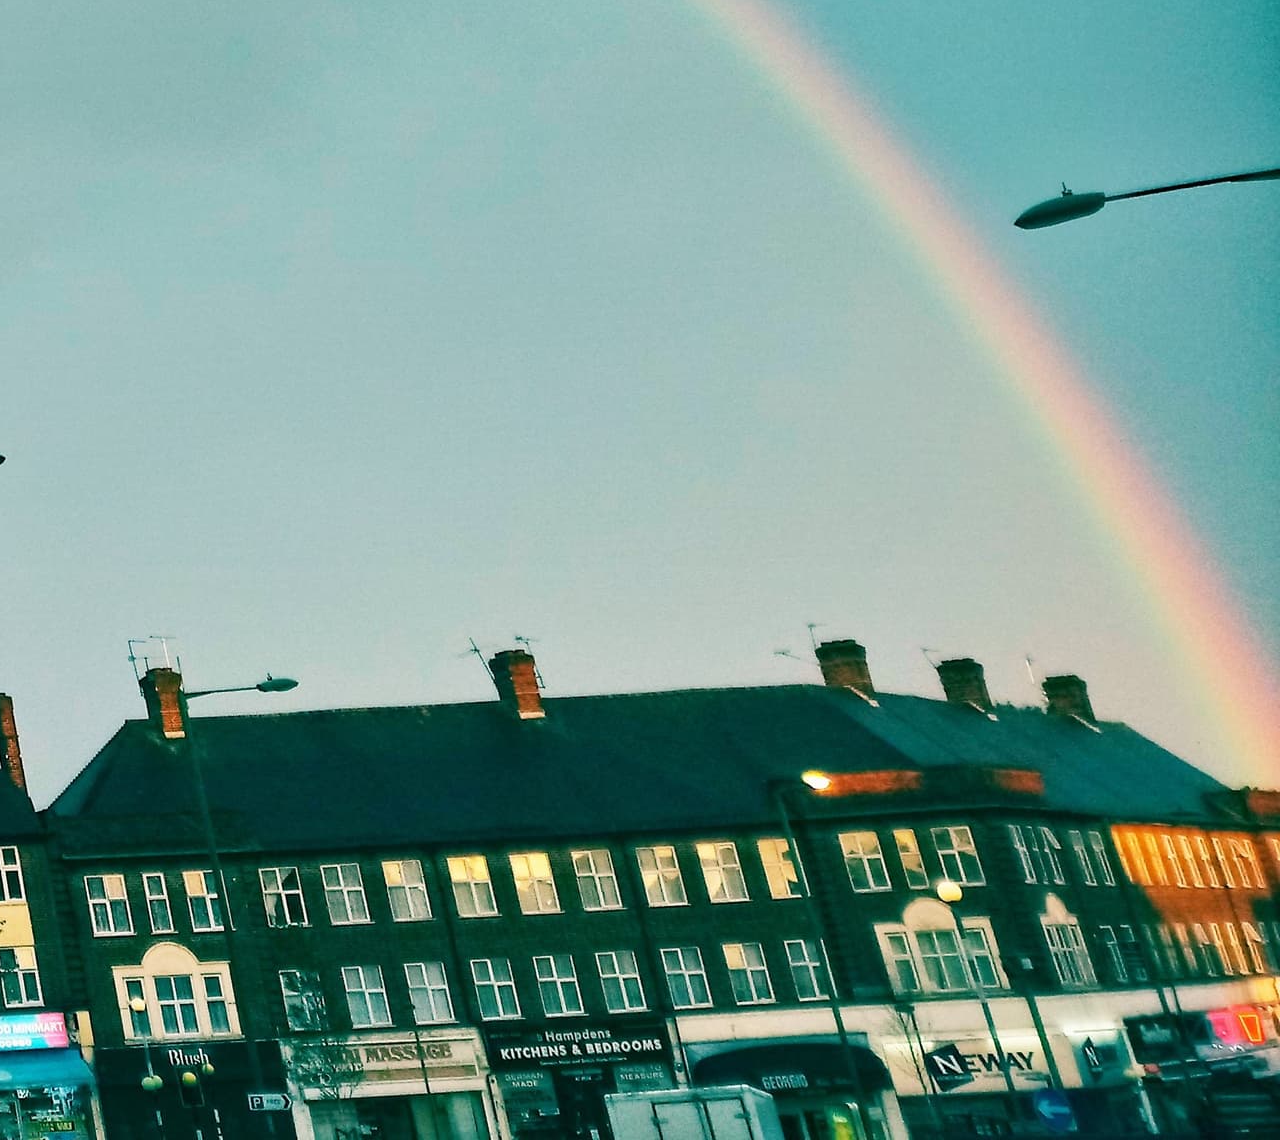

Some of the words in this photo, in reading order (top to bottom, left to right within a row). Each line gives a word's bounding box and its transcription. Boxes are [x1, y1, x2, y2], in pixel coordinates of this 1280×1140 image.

[544, 1028, 612, 1044] Hampdens
[168, 1047, 210, 1066] Blush
[500, 1045, 568, 1061] KITCHENS
[571, 1045, 583, 1056] &
[585, 1038, 663, 1055] BEDROOMS
